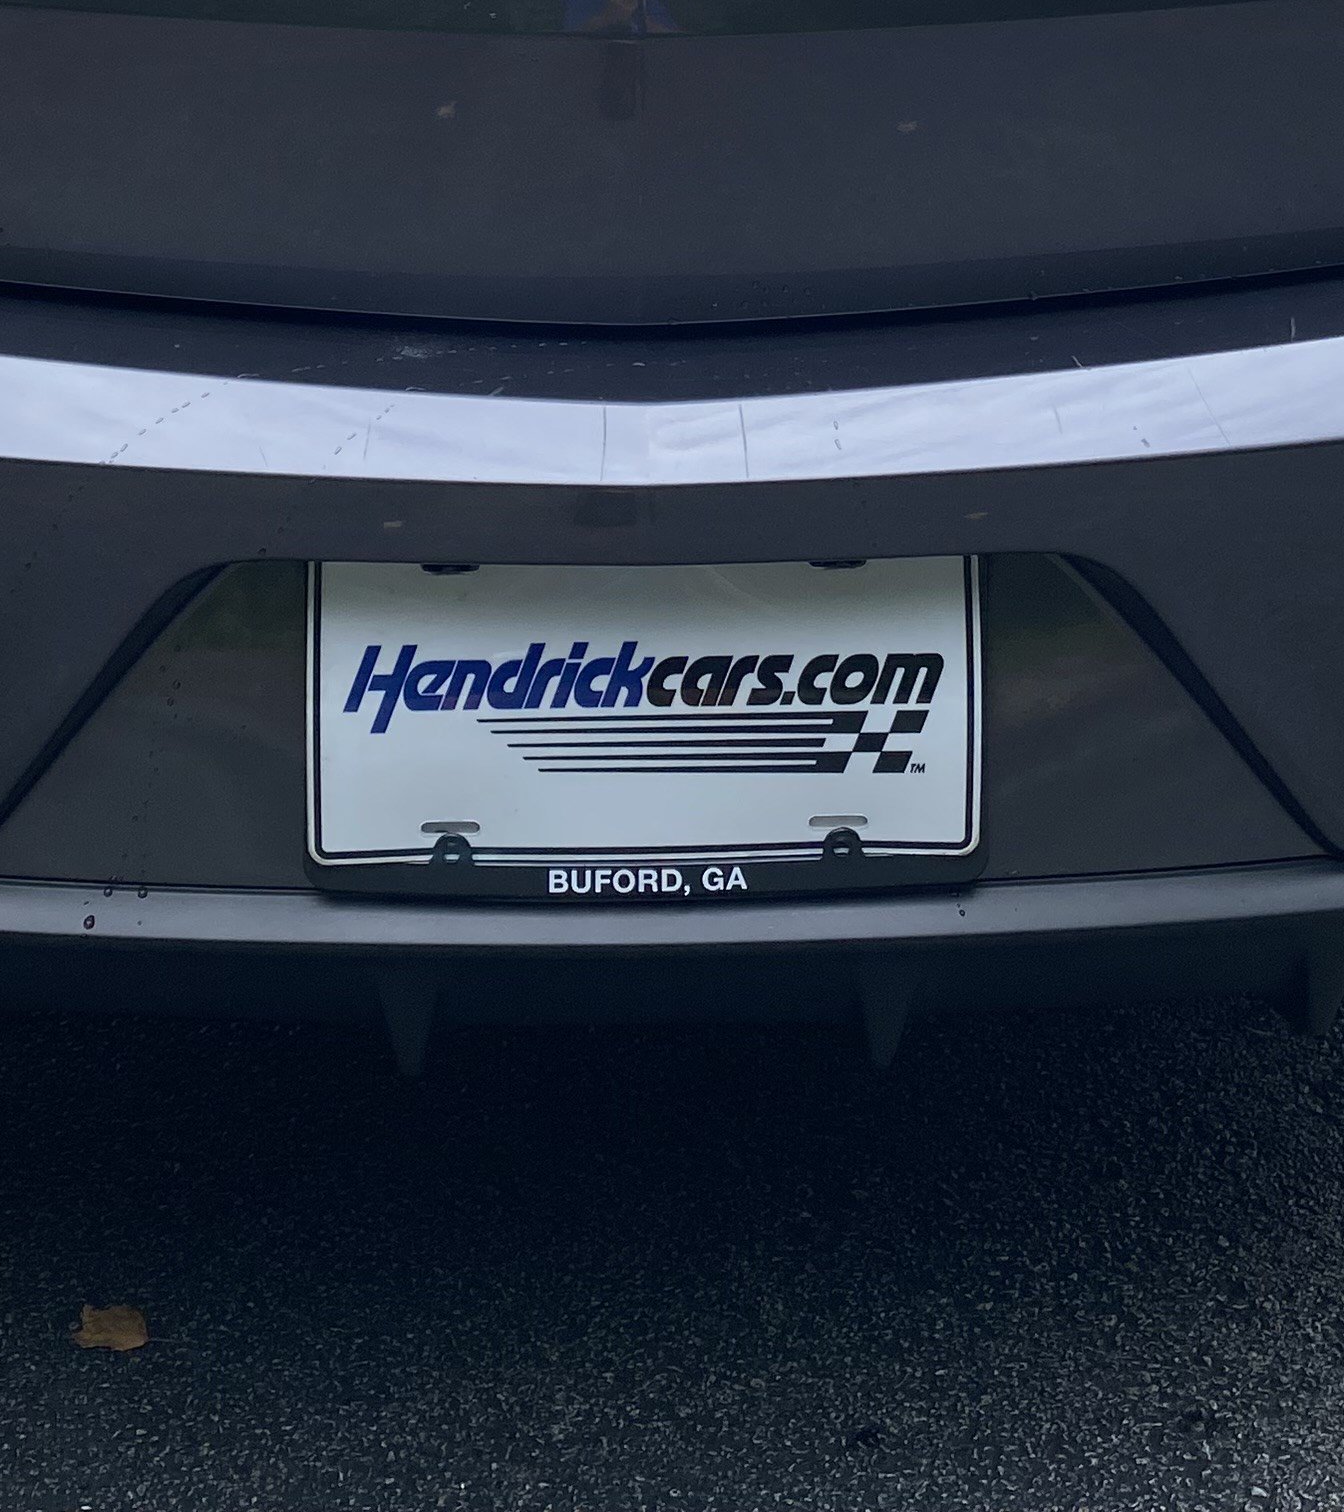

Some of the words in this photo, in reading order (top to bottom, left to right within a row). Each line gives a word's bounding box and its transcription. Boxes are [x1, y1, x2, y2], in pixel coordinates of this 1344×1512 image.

[343, 641, 944, 734] Hendrickcars.com
[548, 869, 691, 897] BUFORD,
[701, 867, 748, 893] GA
